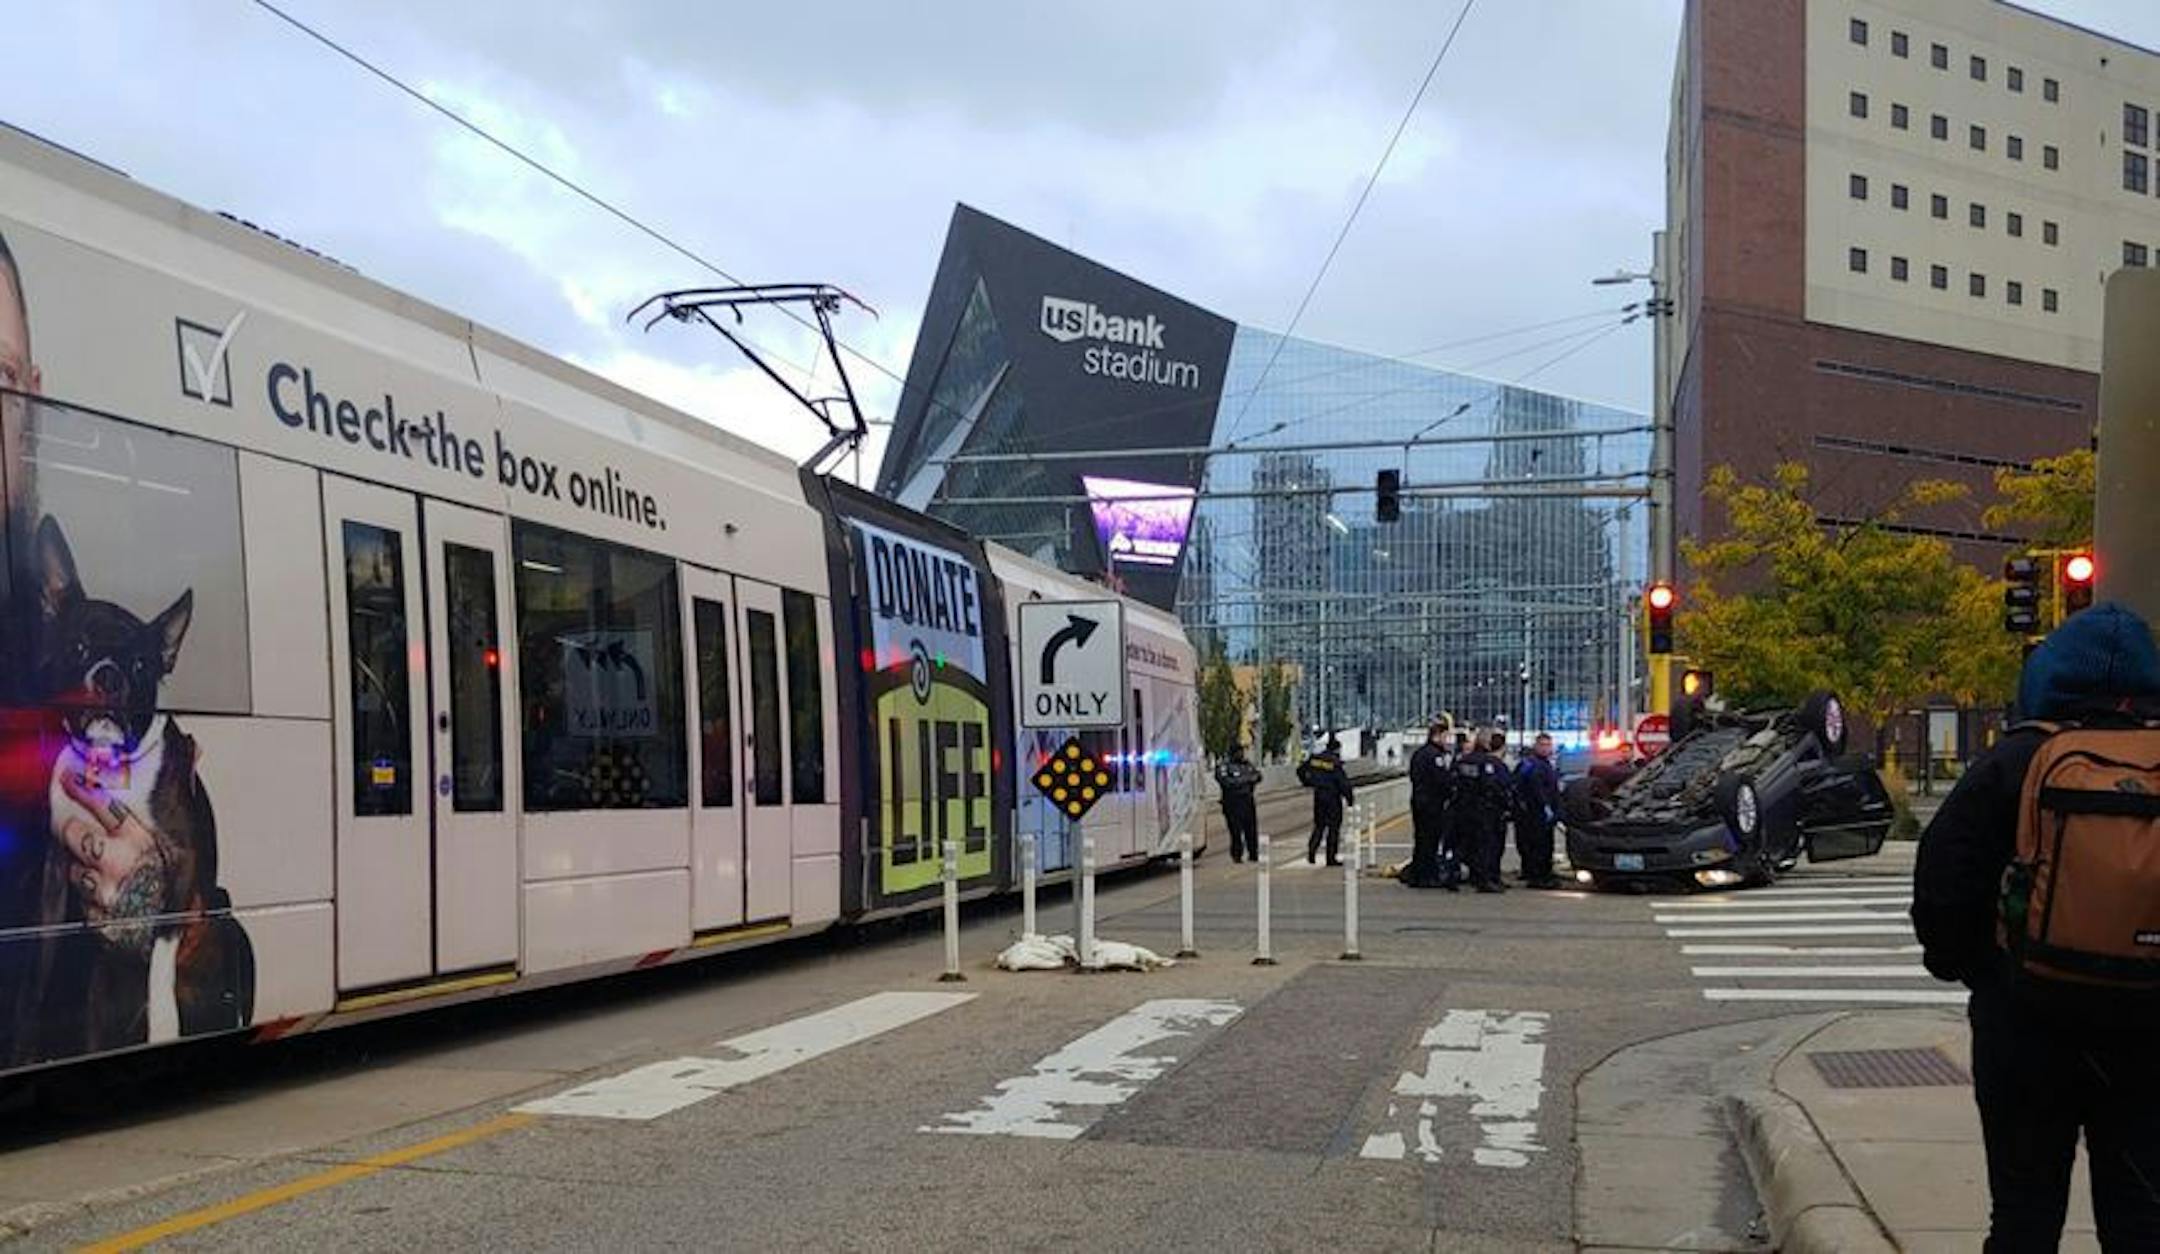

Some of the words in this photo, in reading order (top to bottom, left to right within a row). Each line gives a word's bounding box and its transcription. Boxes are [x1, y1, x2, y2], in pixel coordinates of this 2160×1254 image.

[1083, 344, 1199, 389] stadium
[267, 362, 412, 458] Check
[423, 410, 485, 478] the
[495, 429, 560, 500] box
[569, 466, 667, 531] online.
[872, 535, 978, 637] DONATE
[1036, 691, 1108, 716] ONLY
[889, 718, 985, 866] LIFE
